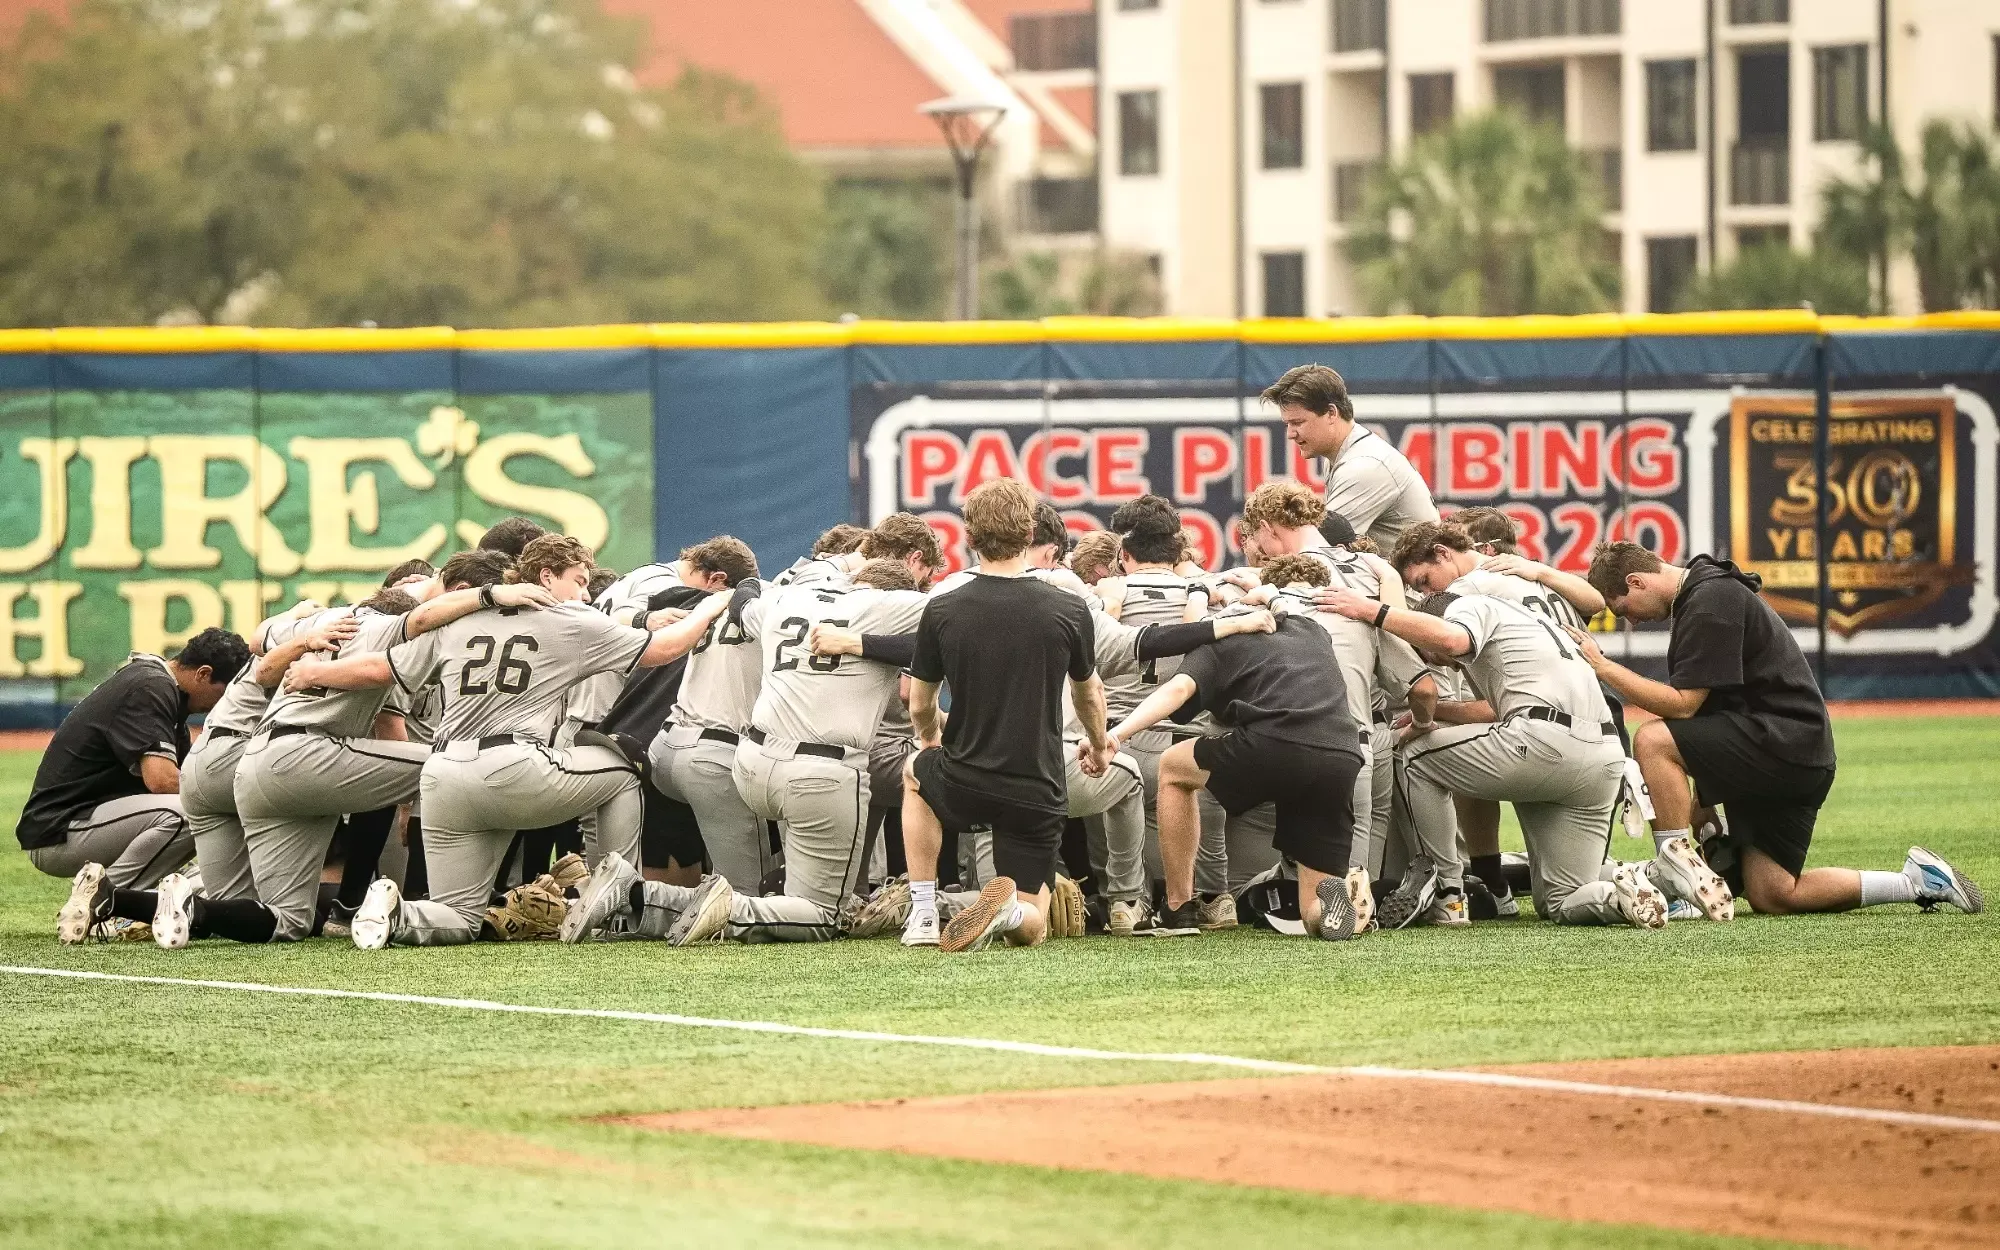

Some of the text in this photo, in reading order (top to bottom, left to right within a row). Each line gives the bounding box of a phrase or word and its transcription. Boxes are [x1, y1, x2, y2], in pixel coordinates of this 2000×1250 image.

[1751, 419, 1936, 443] CELEBRATING
[901, 427, 1150, 507] PACE
[1766, 527, 1915, 560] YEARS
[459, 634, 540, 696] 26
